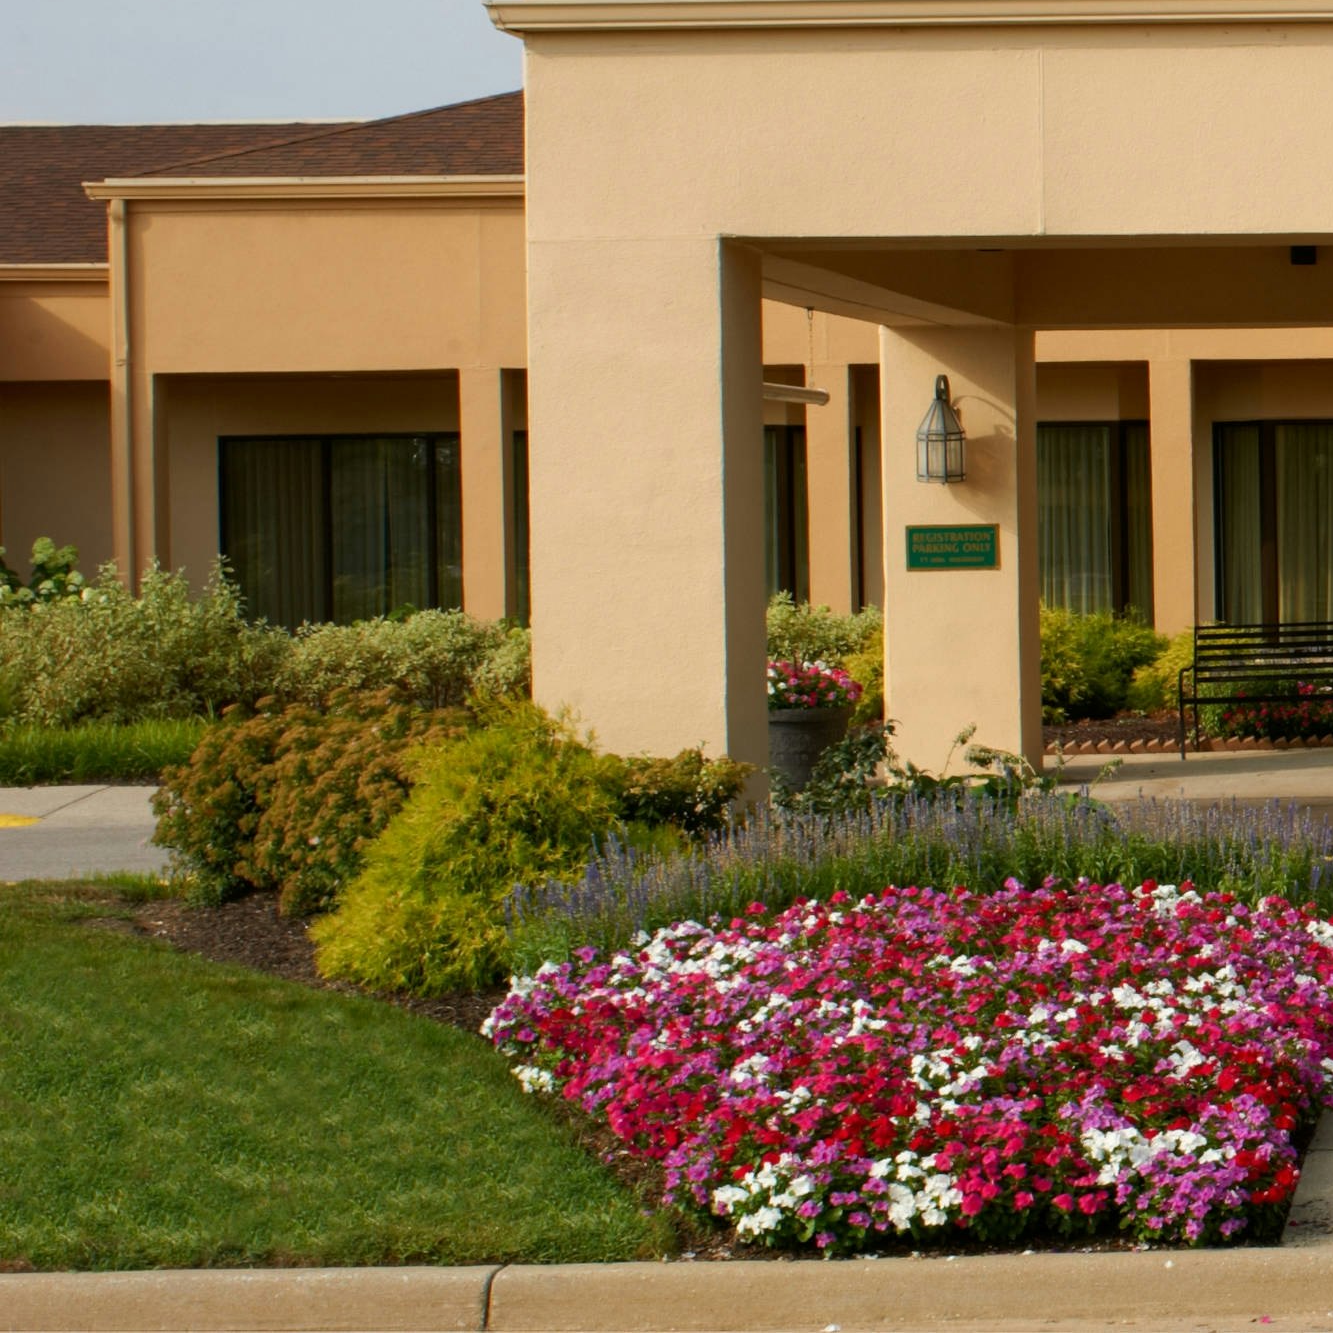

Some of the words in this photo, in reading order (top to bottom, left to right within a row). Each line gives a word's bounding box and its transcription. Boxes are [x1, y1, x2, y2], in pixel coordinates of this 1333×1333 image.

[912, 532, 990, 542] REGISTRATION
[912, 543, 959, 554] PARKING
[962, 542, 991, 553] ONLY
